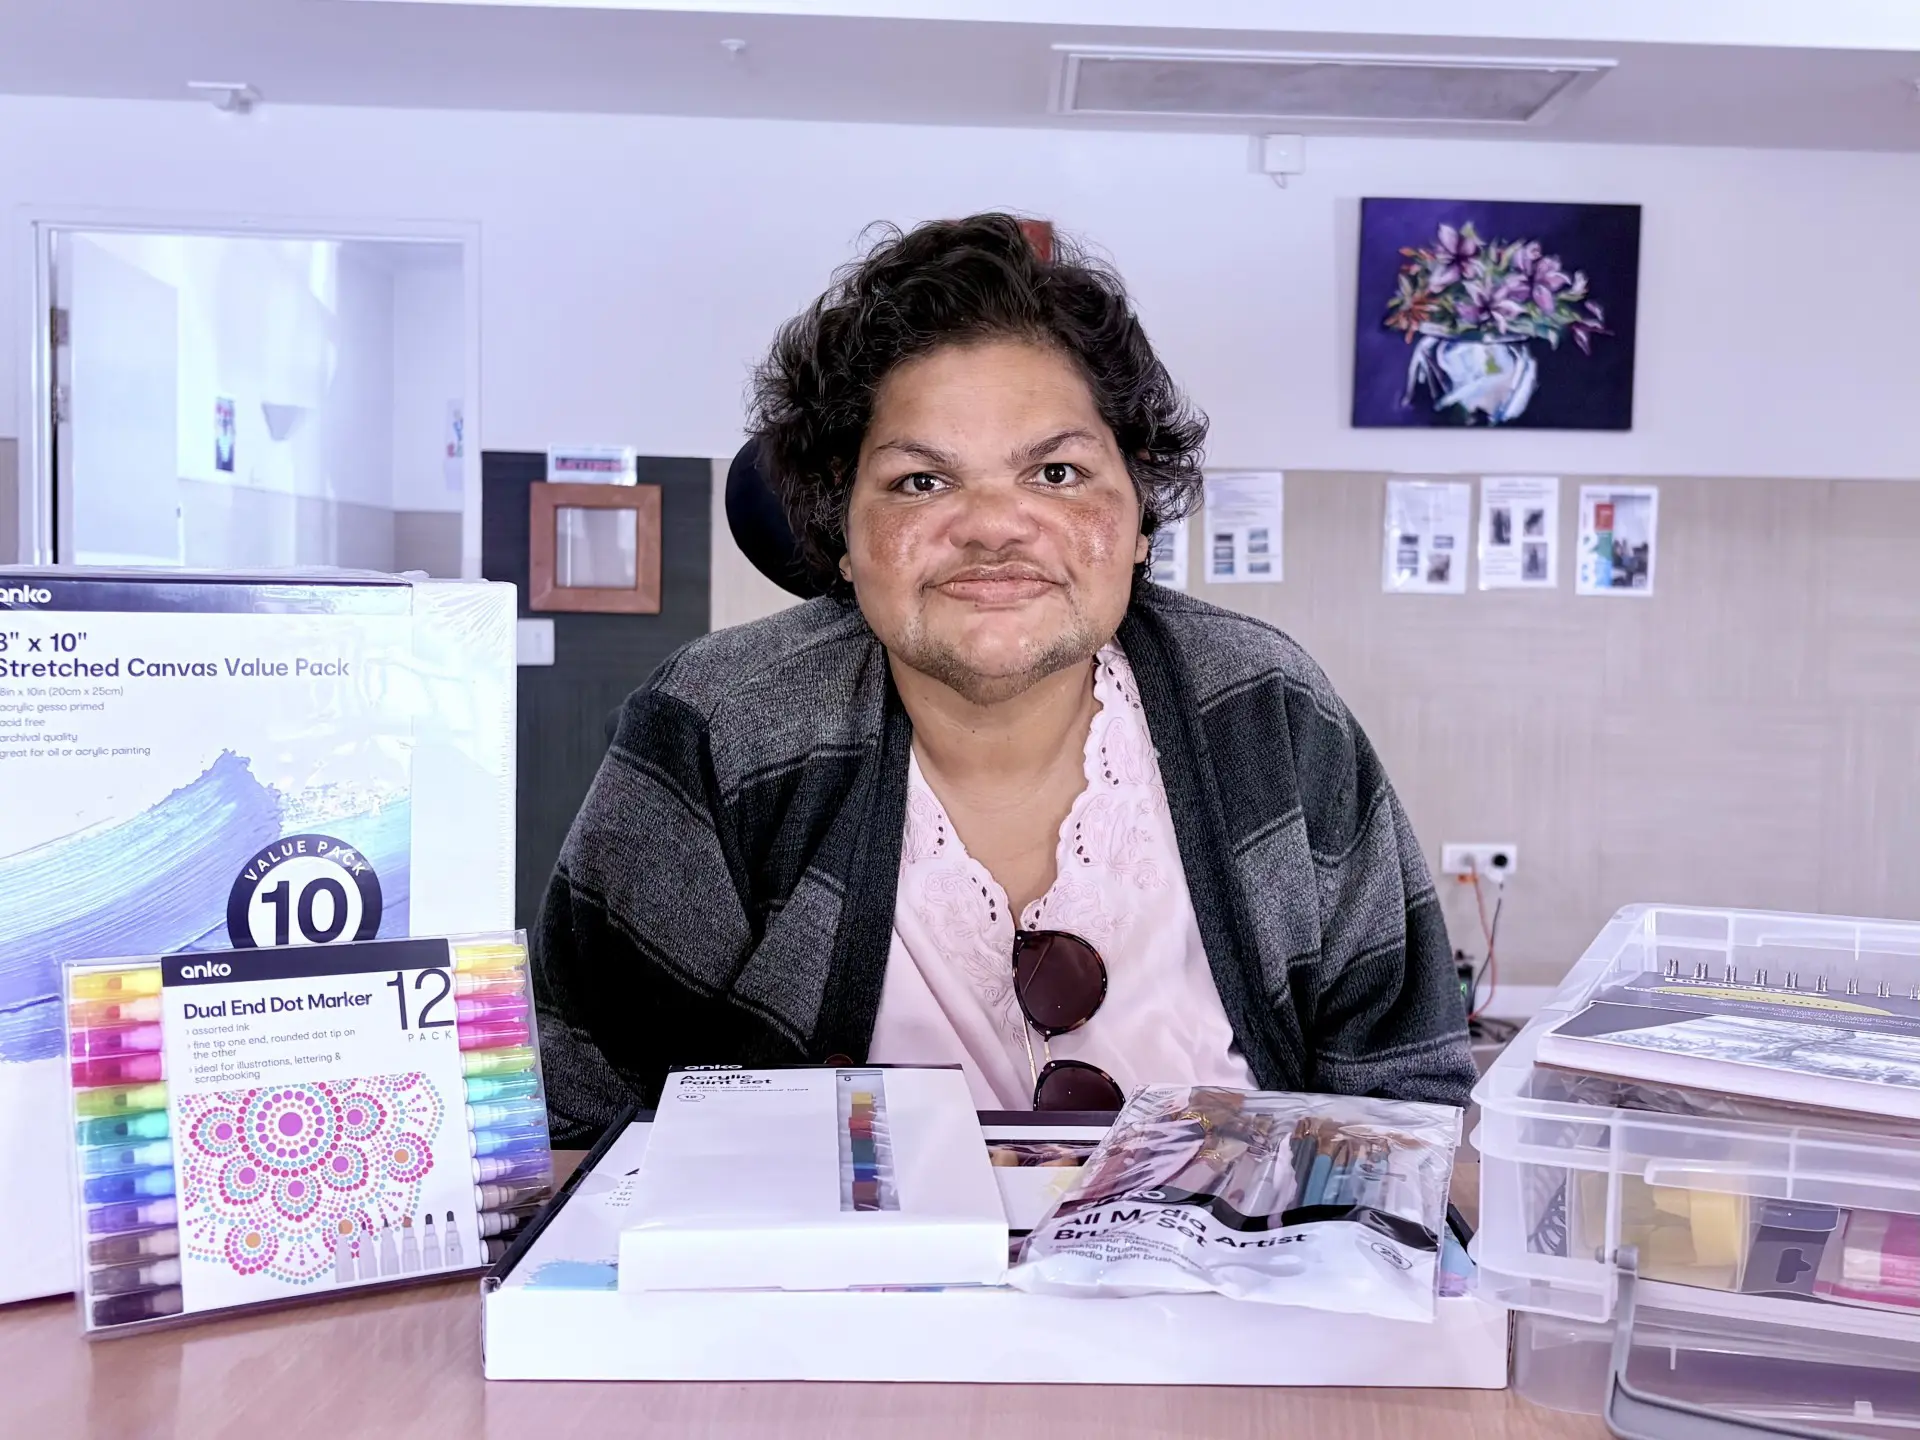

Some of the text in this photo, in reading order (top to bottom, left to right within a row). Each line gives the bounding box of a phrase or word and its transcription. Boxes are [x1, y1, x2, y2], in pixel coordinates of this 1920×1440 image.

[28, 638, 42, 652] x
[50, 632, 87, 652] 10"
[0, 657, 350, 677] Stretched Canvas Value Pack
[27, 687, 46, 696] 10in
[48, 686, 81, 698] (20cm
[92, 685, 124, 697] 25cm)
[0, 702, 104, 714] acrylic gesso primed
[0, 718, 46, 727] acid free
[0, 731, 78, 743] archival quality
[0, 745, 151, 760] great for oil or acrylic painting
[244, 840, 367, 883] VALUE PACK
[261, 877, 348, 946] 10
[180, 961, 232, 979] anko
[184, 991, 373, 1020] Dual End Dot Marker
[386, 968, 455, 1030] 12
[192, 1023, 250, 1036] assorted ink
[193, 1028, 356, 1049] fine tip one end, rounded dot tip on
[407, 1030, 452, 1042] PACK
[193, 1047, 237, 1060] the other
[194, 1051, 342, 1074] ideal for illustrations, lettering &
[195, 1071, 261, 1084] scrapbooking
[1156, 1217, 1209, 1248] Set
[1215, 1233, 1309, 1250] Artist
